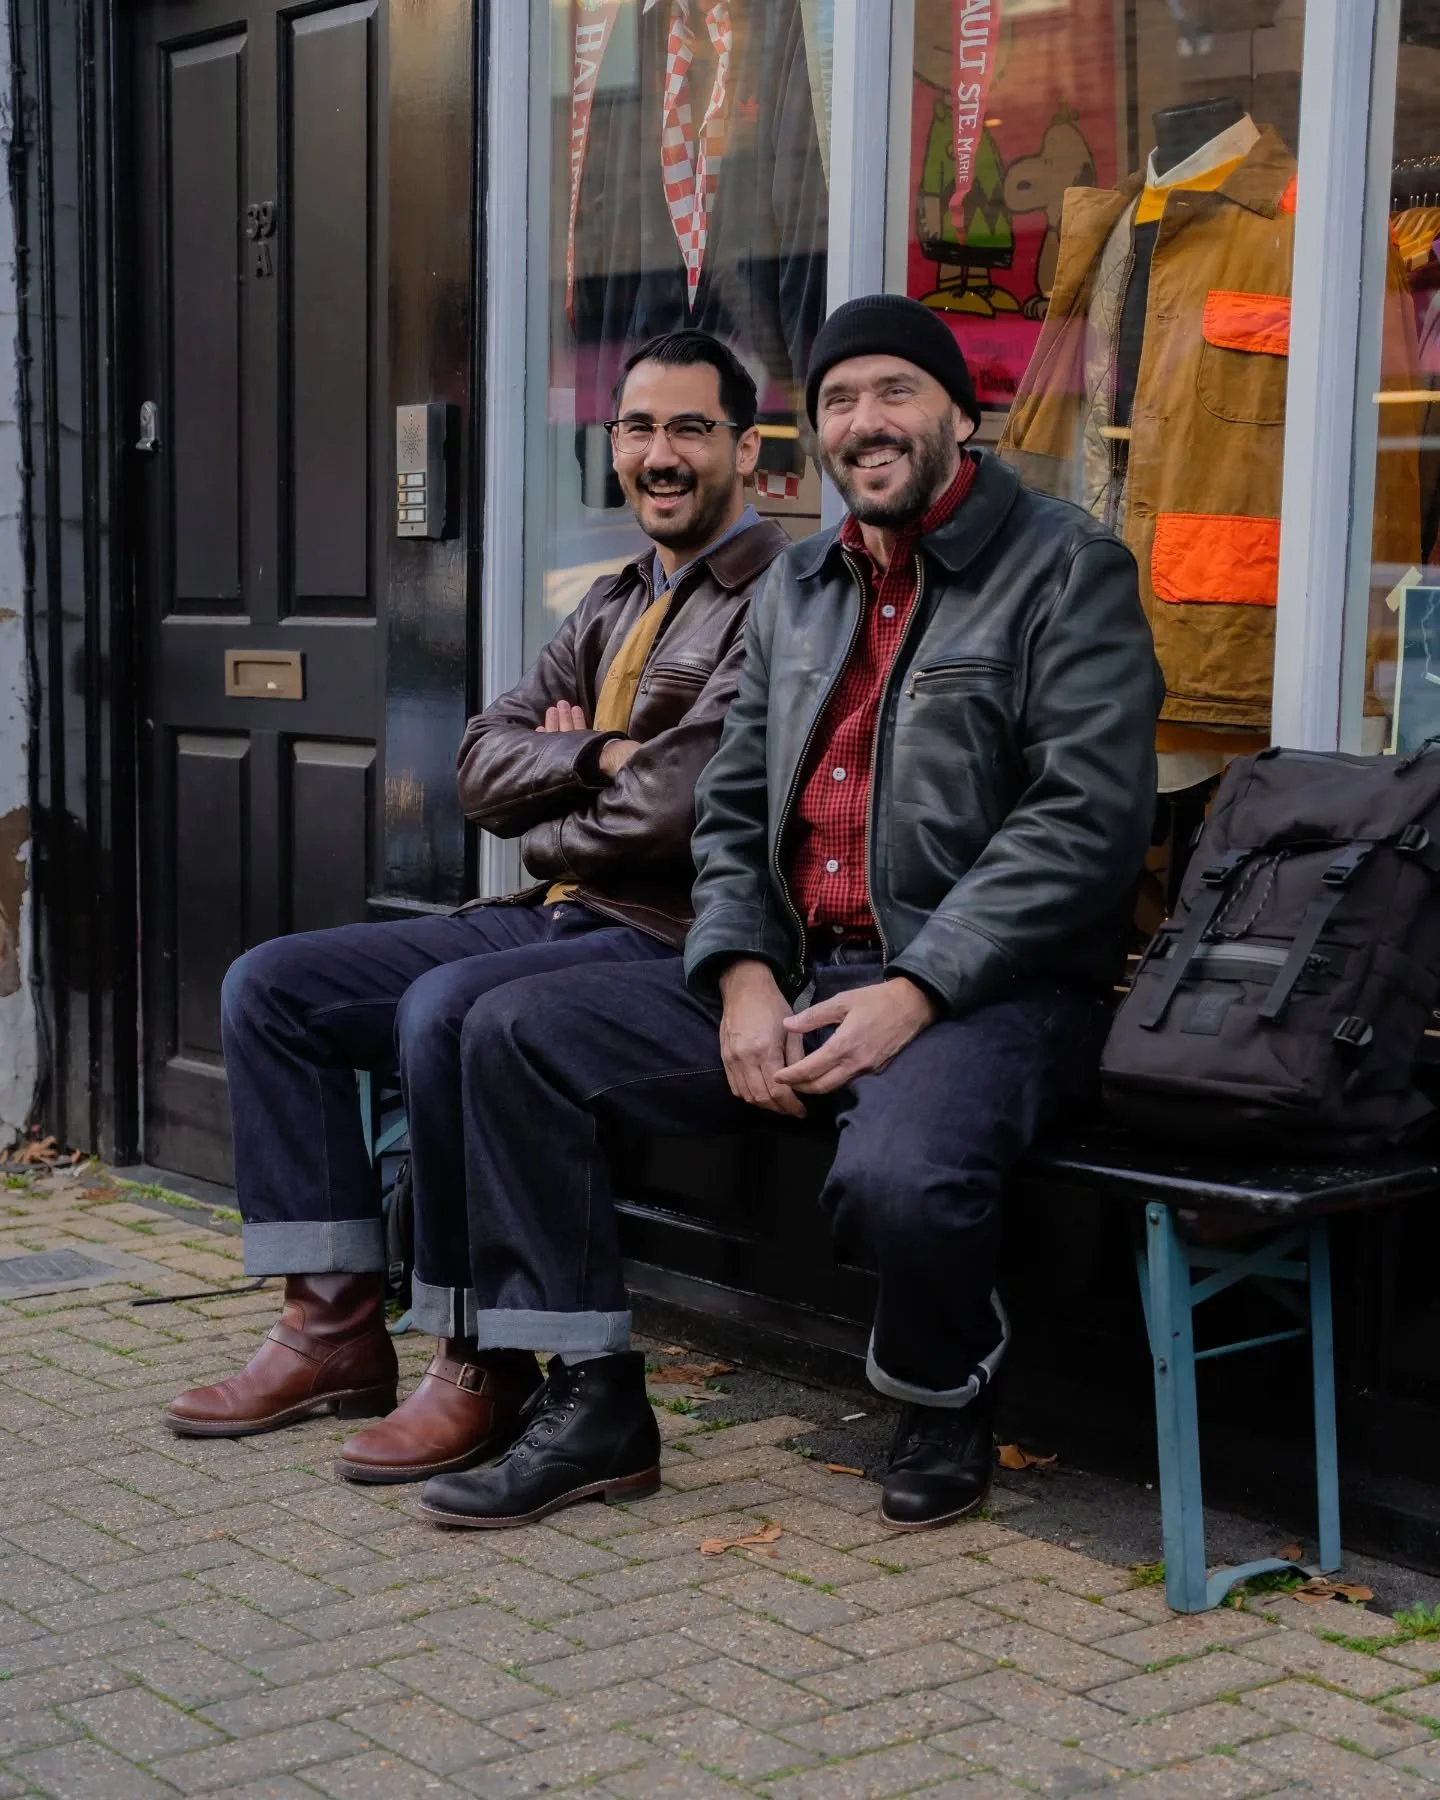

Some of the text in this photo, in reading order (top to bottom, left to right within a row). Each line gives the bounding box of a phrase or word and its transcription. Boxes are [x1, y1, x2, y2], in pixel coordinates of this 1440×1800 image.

[958, 80, 981, 134] STE.
[957, 137, 974, 183] MARIE
[254, 241, 270, 277] A
